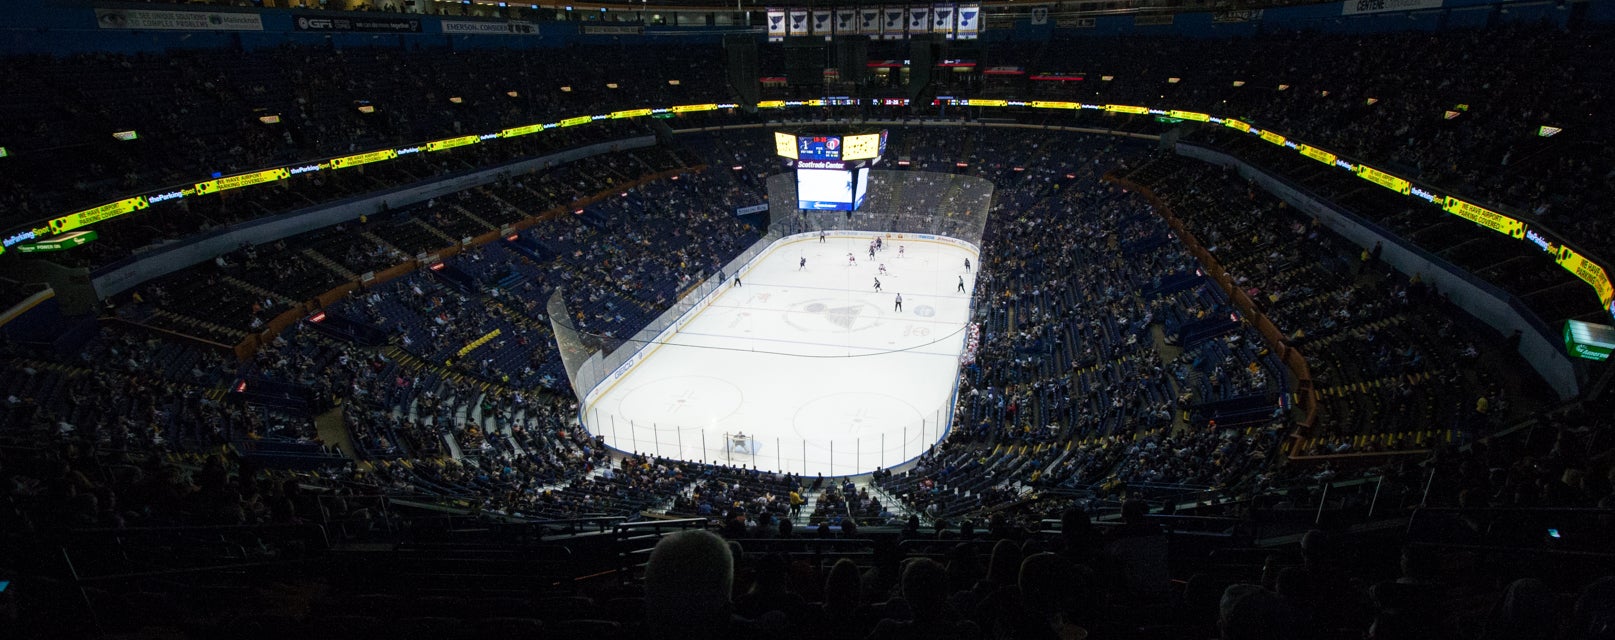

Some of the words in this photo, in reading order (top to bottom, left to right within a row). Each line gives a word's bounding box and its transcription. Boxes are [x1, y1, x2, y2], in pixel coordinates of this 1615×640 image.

[241, 173, 262, 181] AIRPORT
[149, 187, 195, 204] theParkingSpot
[87, 208, 100, 217] HAVE
[100, 202, 120, 212] AIRPORT
[1459, 209, 1478, 222] PARKING
[1469, 205, 1481, 216] HAVE
[1482, 210, 1502, 222] AIRPORT
[79, 214, 101, 226] PARKING
[4, 226, 50, 248] theParkingSpot
[615, 359, 633, 379] GEICO
